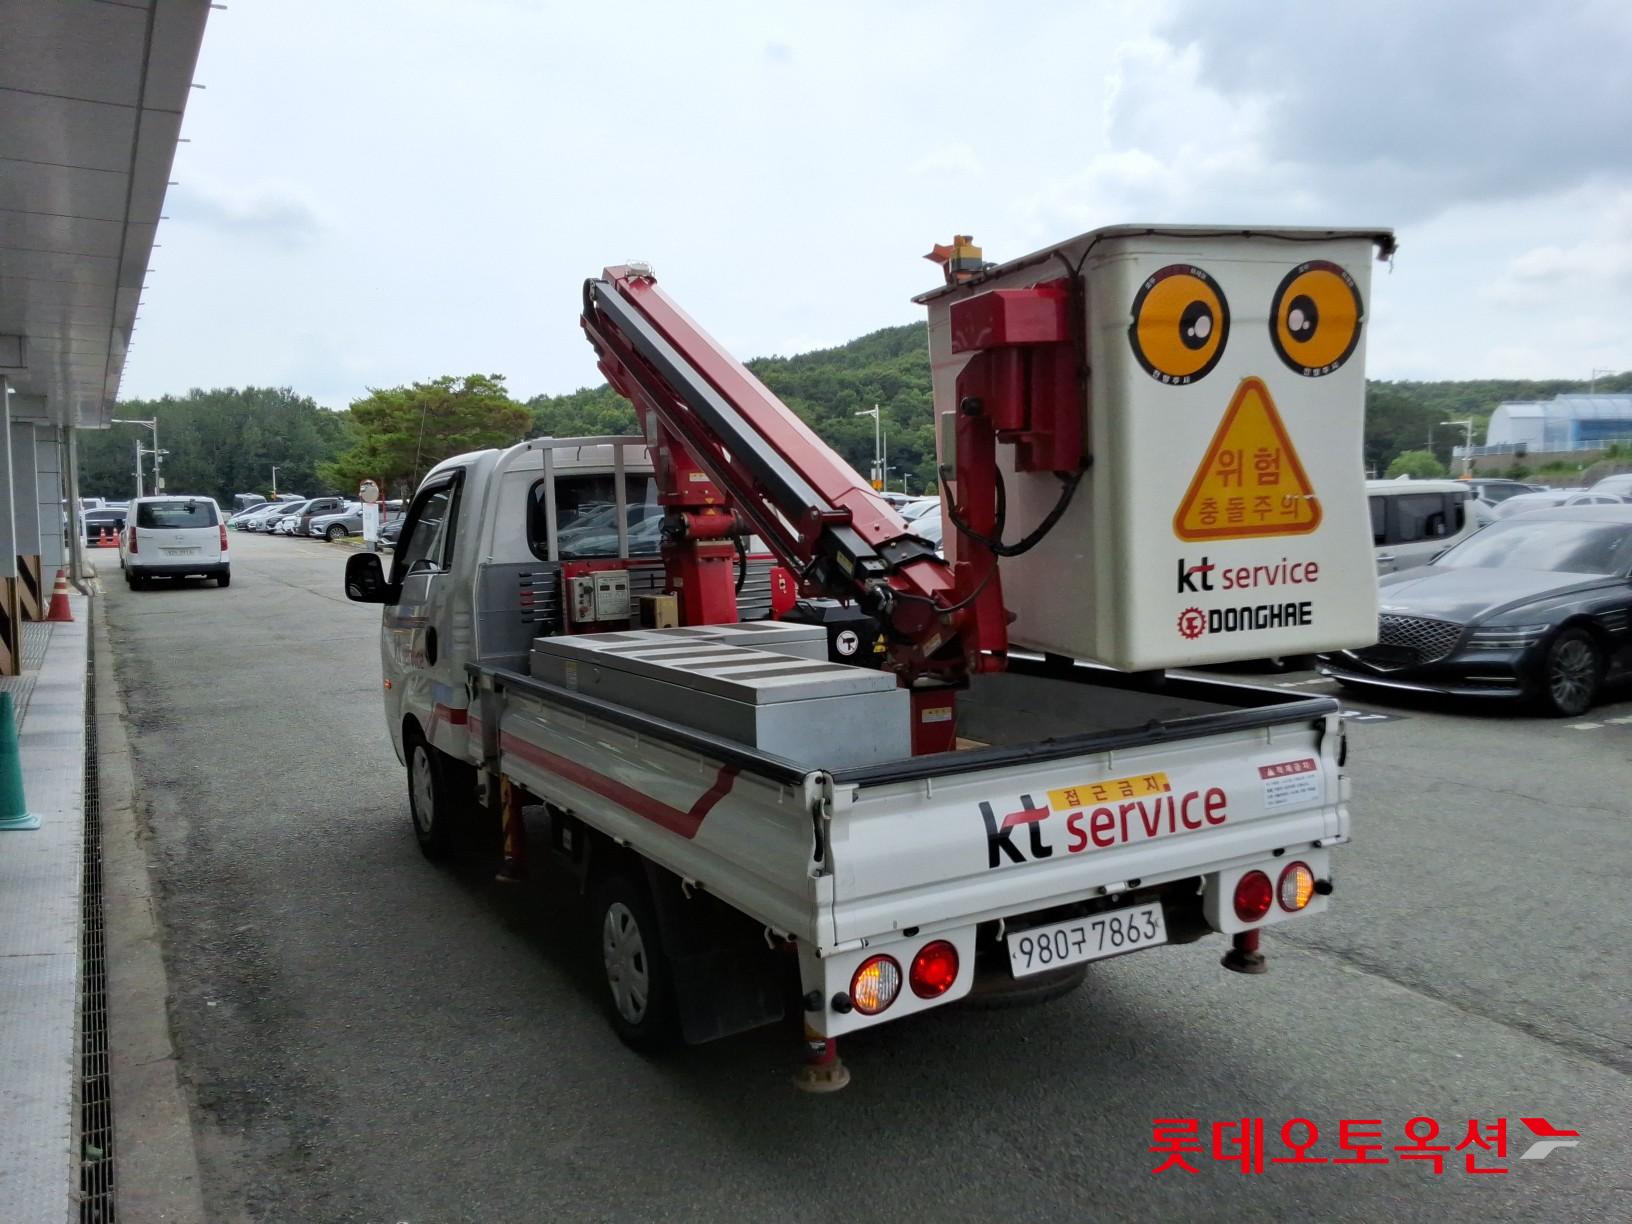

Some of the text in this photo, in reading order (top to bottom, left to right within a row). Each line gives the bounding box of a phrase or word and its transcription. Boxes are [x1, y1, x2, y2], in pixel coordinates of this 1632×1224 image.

[1215, 446, 1281, 488] 위험
[1197, 494, 1300, 526] 충돌주의
[1177, 556, 1319, 594] kt service
[1208, 601, 1312, 634] DONGHAE
[1063, 774, 1159, 807] 접근금지
[979, 793, 1054, 869] kt
[1066, 783, 1228, 853] service
[1091, 910, 1157, 951] 7863
